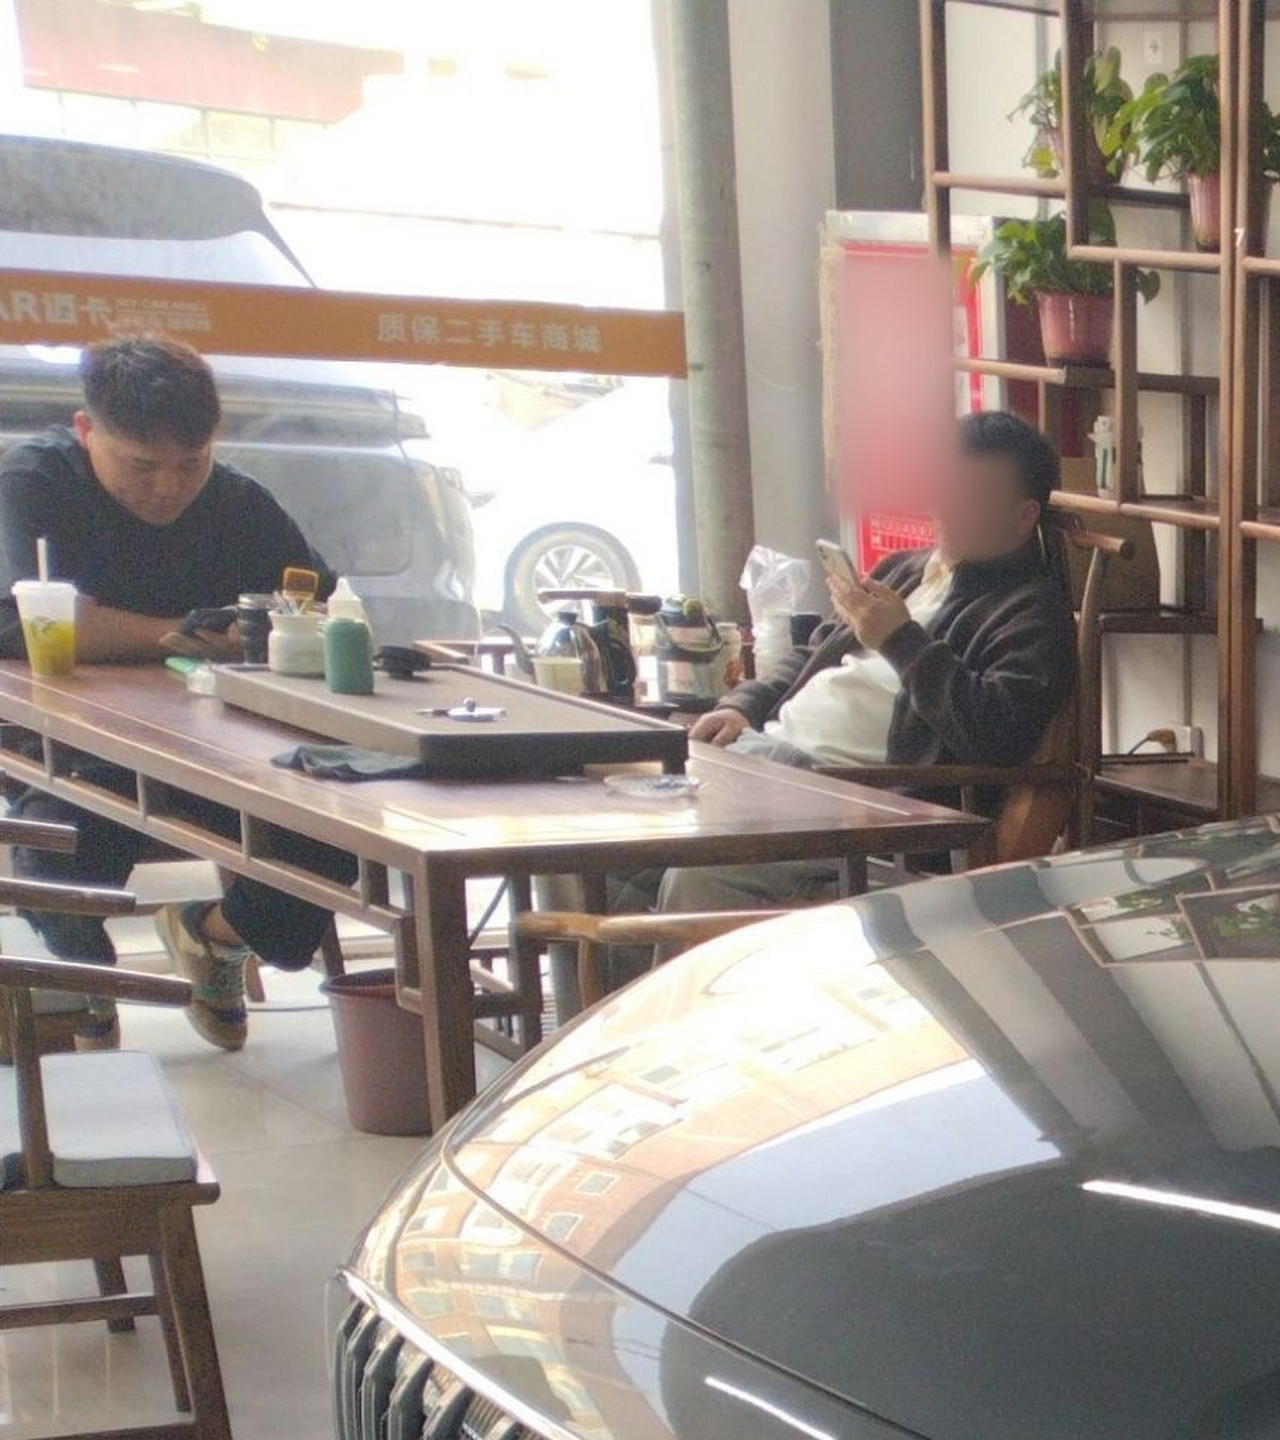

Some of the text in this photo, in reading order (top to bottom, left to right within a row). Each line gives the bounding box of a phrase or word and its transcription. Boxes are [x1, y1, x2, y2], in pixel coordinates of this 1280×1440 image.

[377, 313, 601, 354] 质保二手车商城
